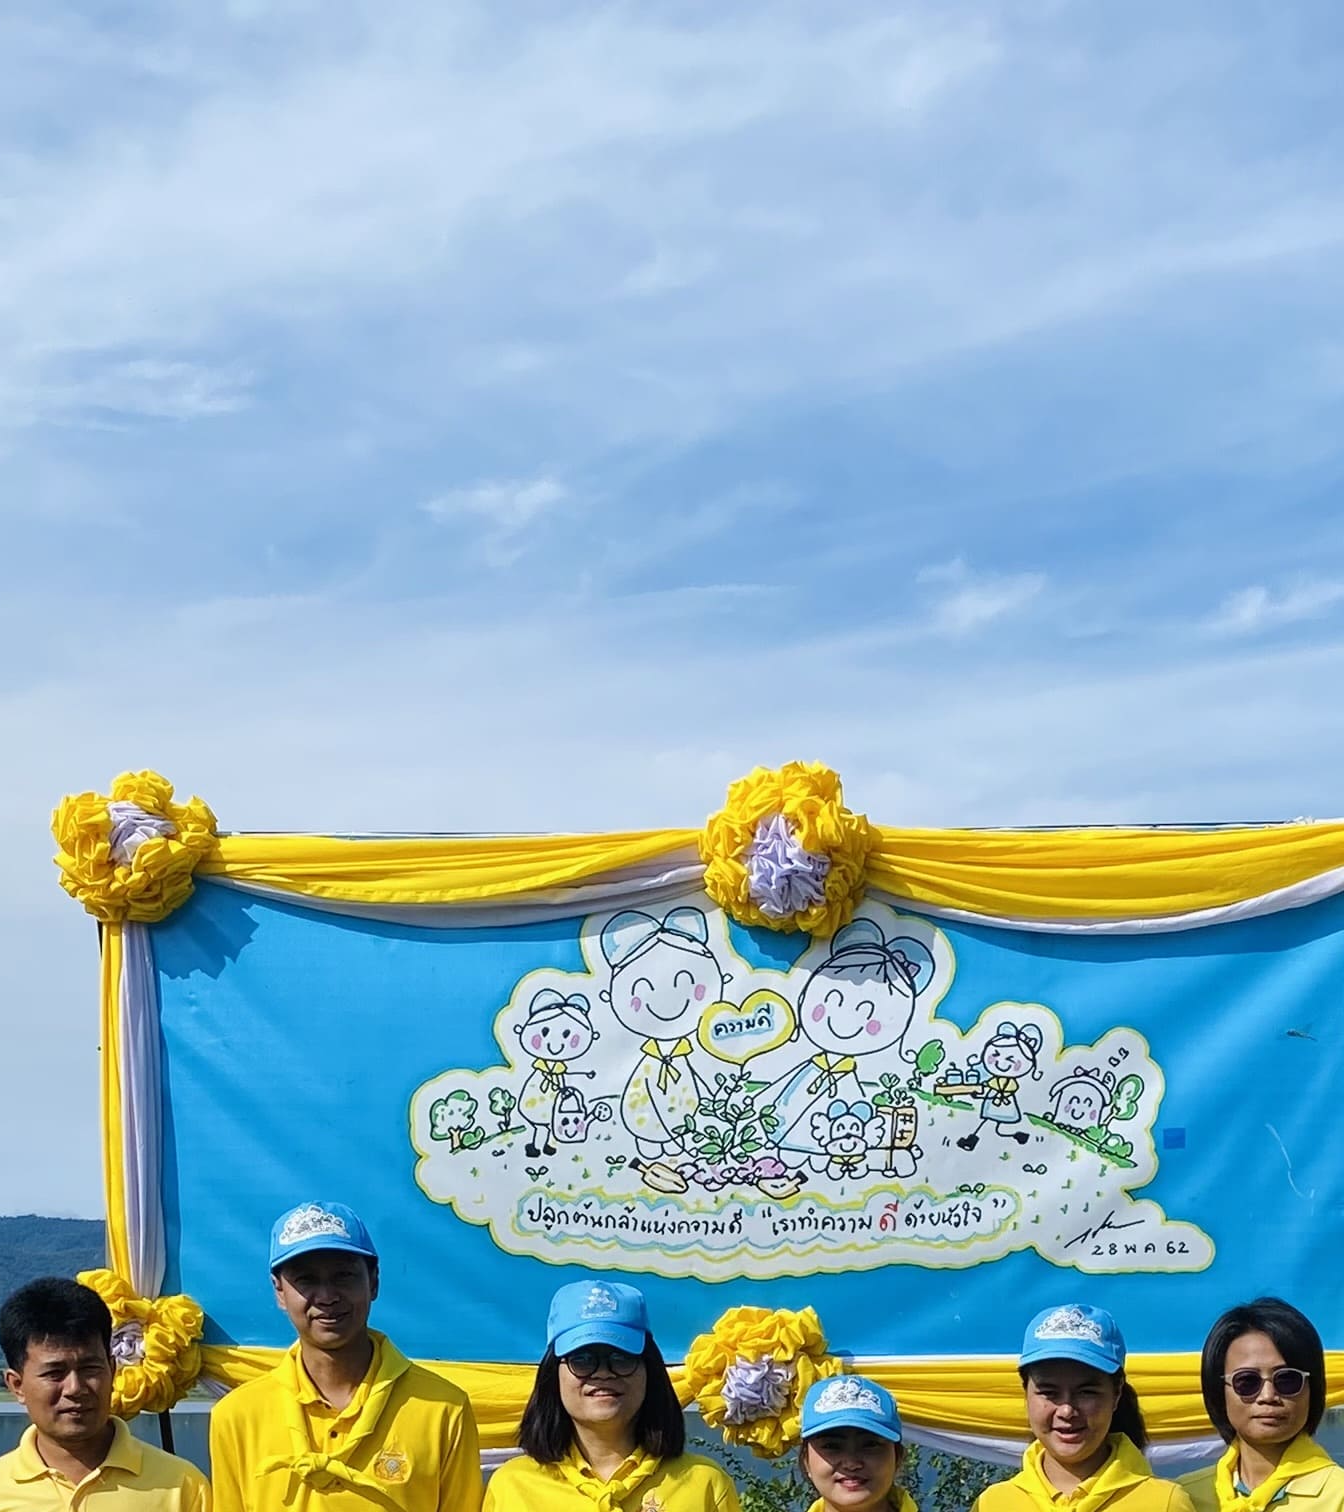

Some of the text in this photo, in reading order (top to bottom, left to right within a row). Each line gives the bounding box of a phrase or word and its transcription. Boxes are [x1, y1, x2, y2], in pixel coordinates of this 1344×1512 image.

[714, 1003, 772, 1036] ความดี
[879, 1200, 899, 1232] ดี
[1092, 1244, 1118, 1256] 28
[1166, 1241, 1190, 1254] 62
